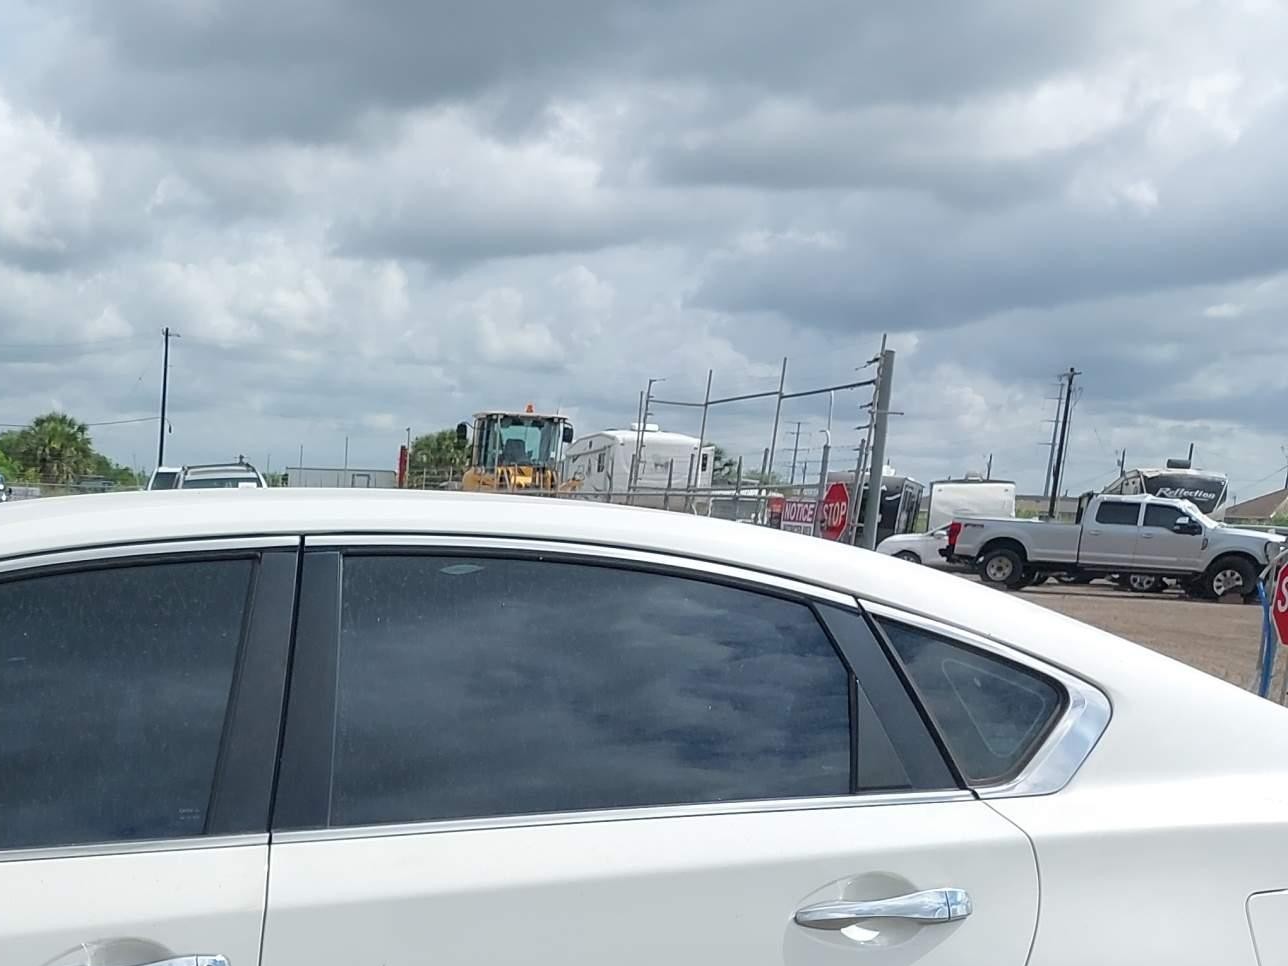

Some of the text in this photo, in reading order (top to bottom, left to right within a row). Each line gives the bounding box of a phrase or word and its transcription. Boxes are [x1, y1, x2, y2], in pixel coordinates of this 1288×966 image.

[1155, 487, 1216, 500] Reflection
[784, 502, 815, 522] NOTICE
[823, 501, 847, 528] STOP
